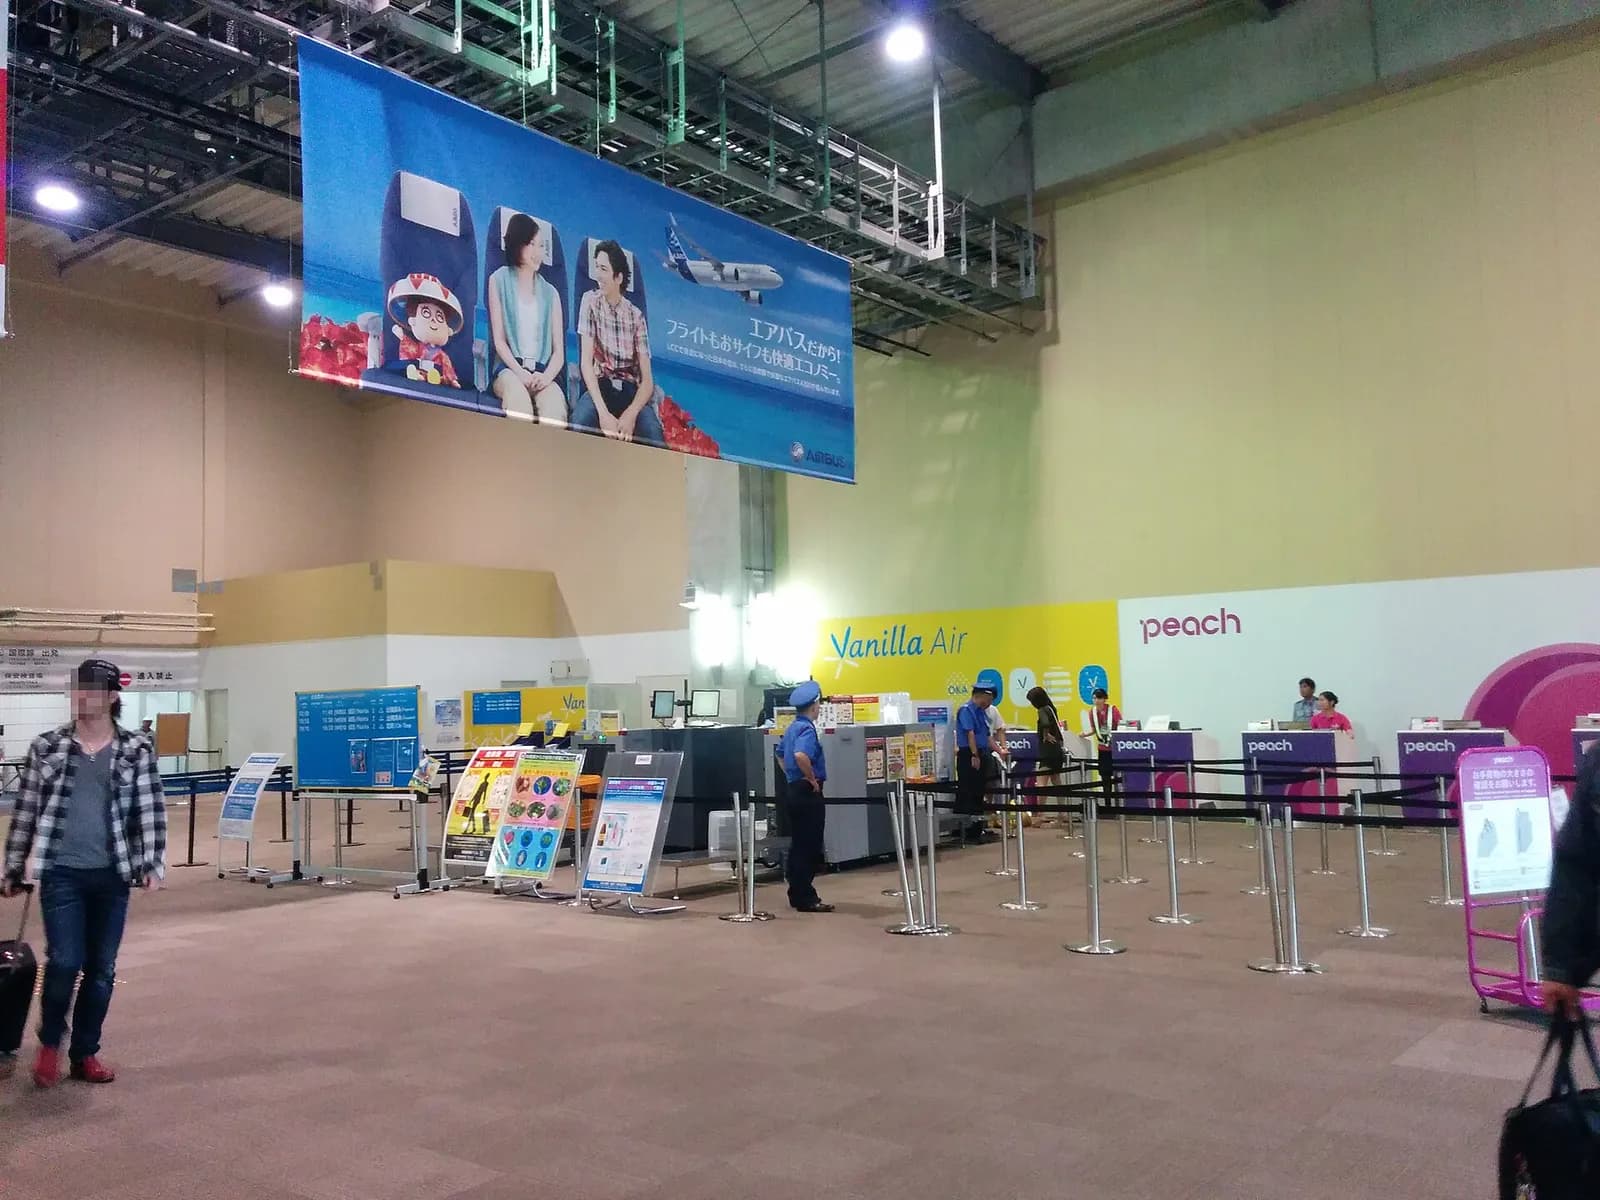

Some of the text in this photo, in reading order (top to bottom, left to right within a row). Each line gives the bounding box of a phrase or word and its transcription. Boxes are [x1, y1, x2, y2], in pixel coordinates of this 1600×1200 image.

[749, 317, 841, 364] エアバスだから!
[1140, 608, 1241, 644] peach
[830, 624, 968, 659] Vanilla Air
[563, 692, 585, 710] Van
[1116, 738, 1156, 752] peach
[1247, 739, 1292, 753] peach
[1403, 739, 1456, 754] peach
